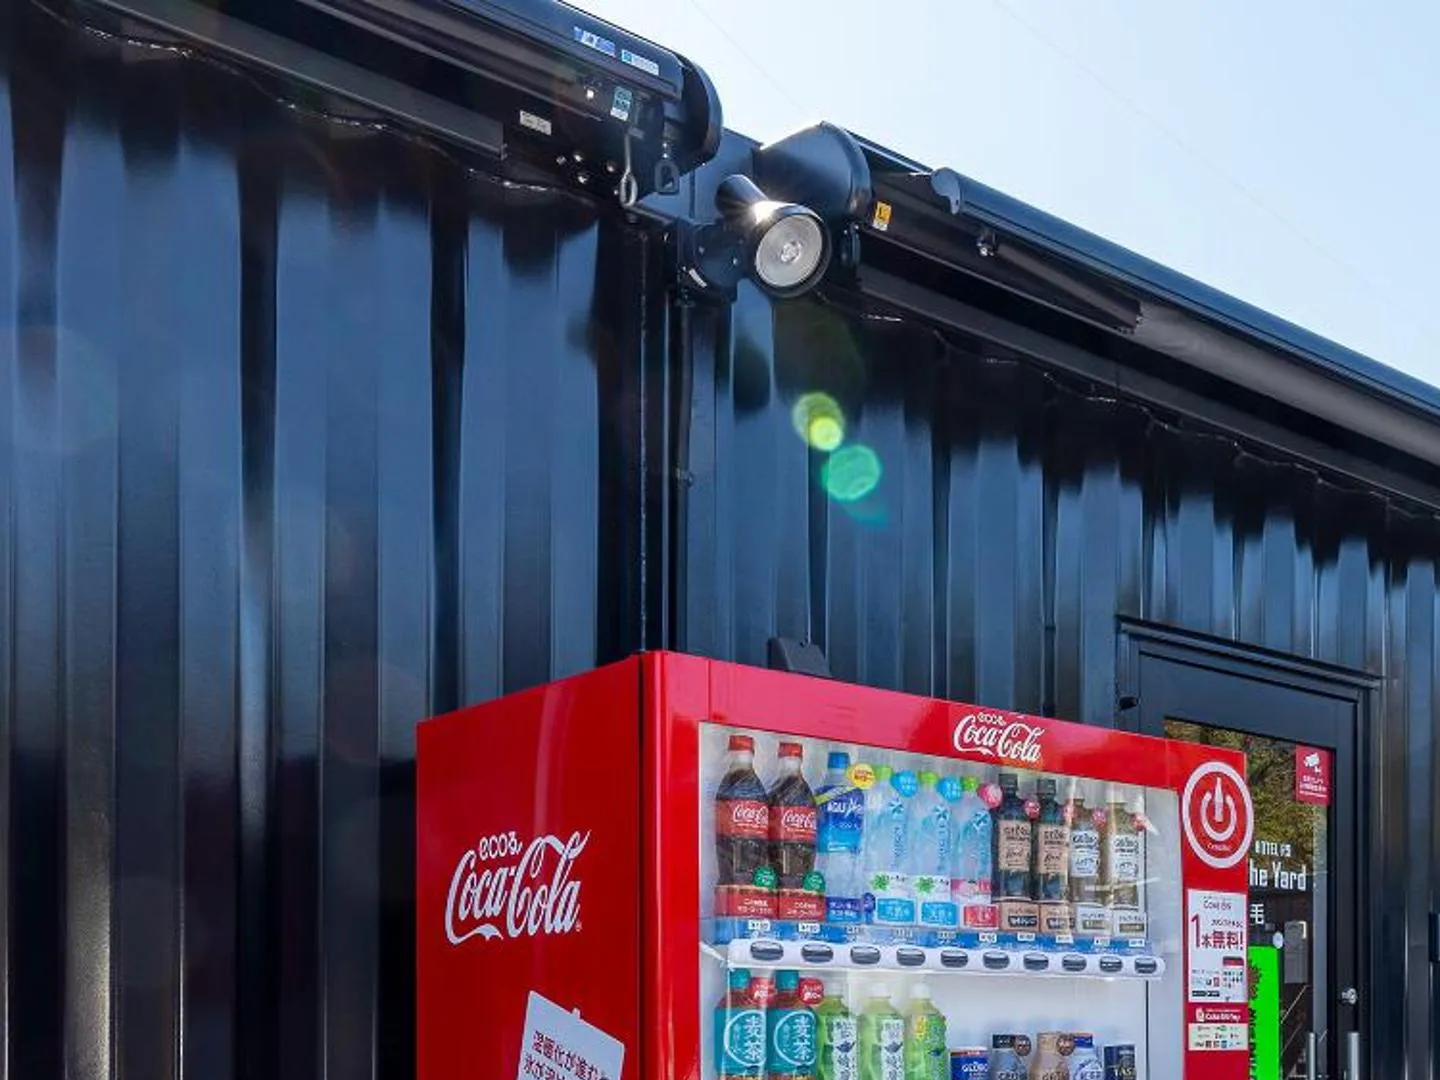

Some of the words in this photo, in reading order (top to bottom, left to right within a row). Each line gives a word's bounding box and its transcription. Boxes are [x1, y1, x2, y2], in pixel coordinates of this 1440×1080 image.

[953, 714, 1045, 763] Coca-Cola
[445, 829, 592, 945] Coca-Cola
[1249, 858, 1268, 887] he
[1272, 861, 1306, 891] Yard
